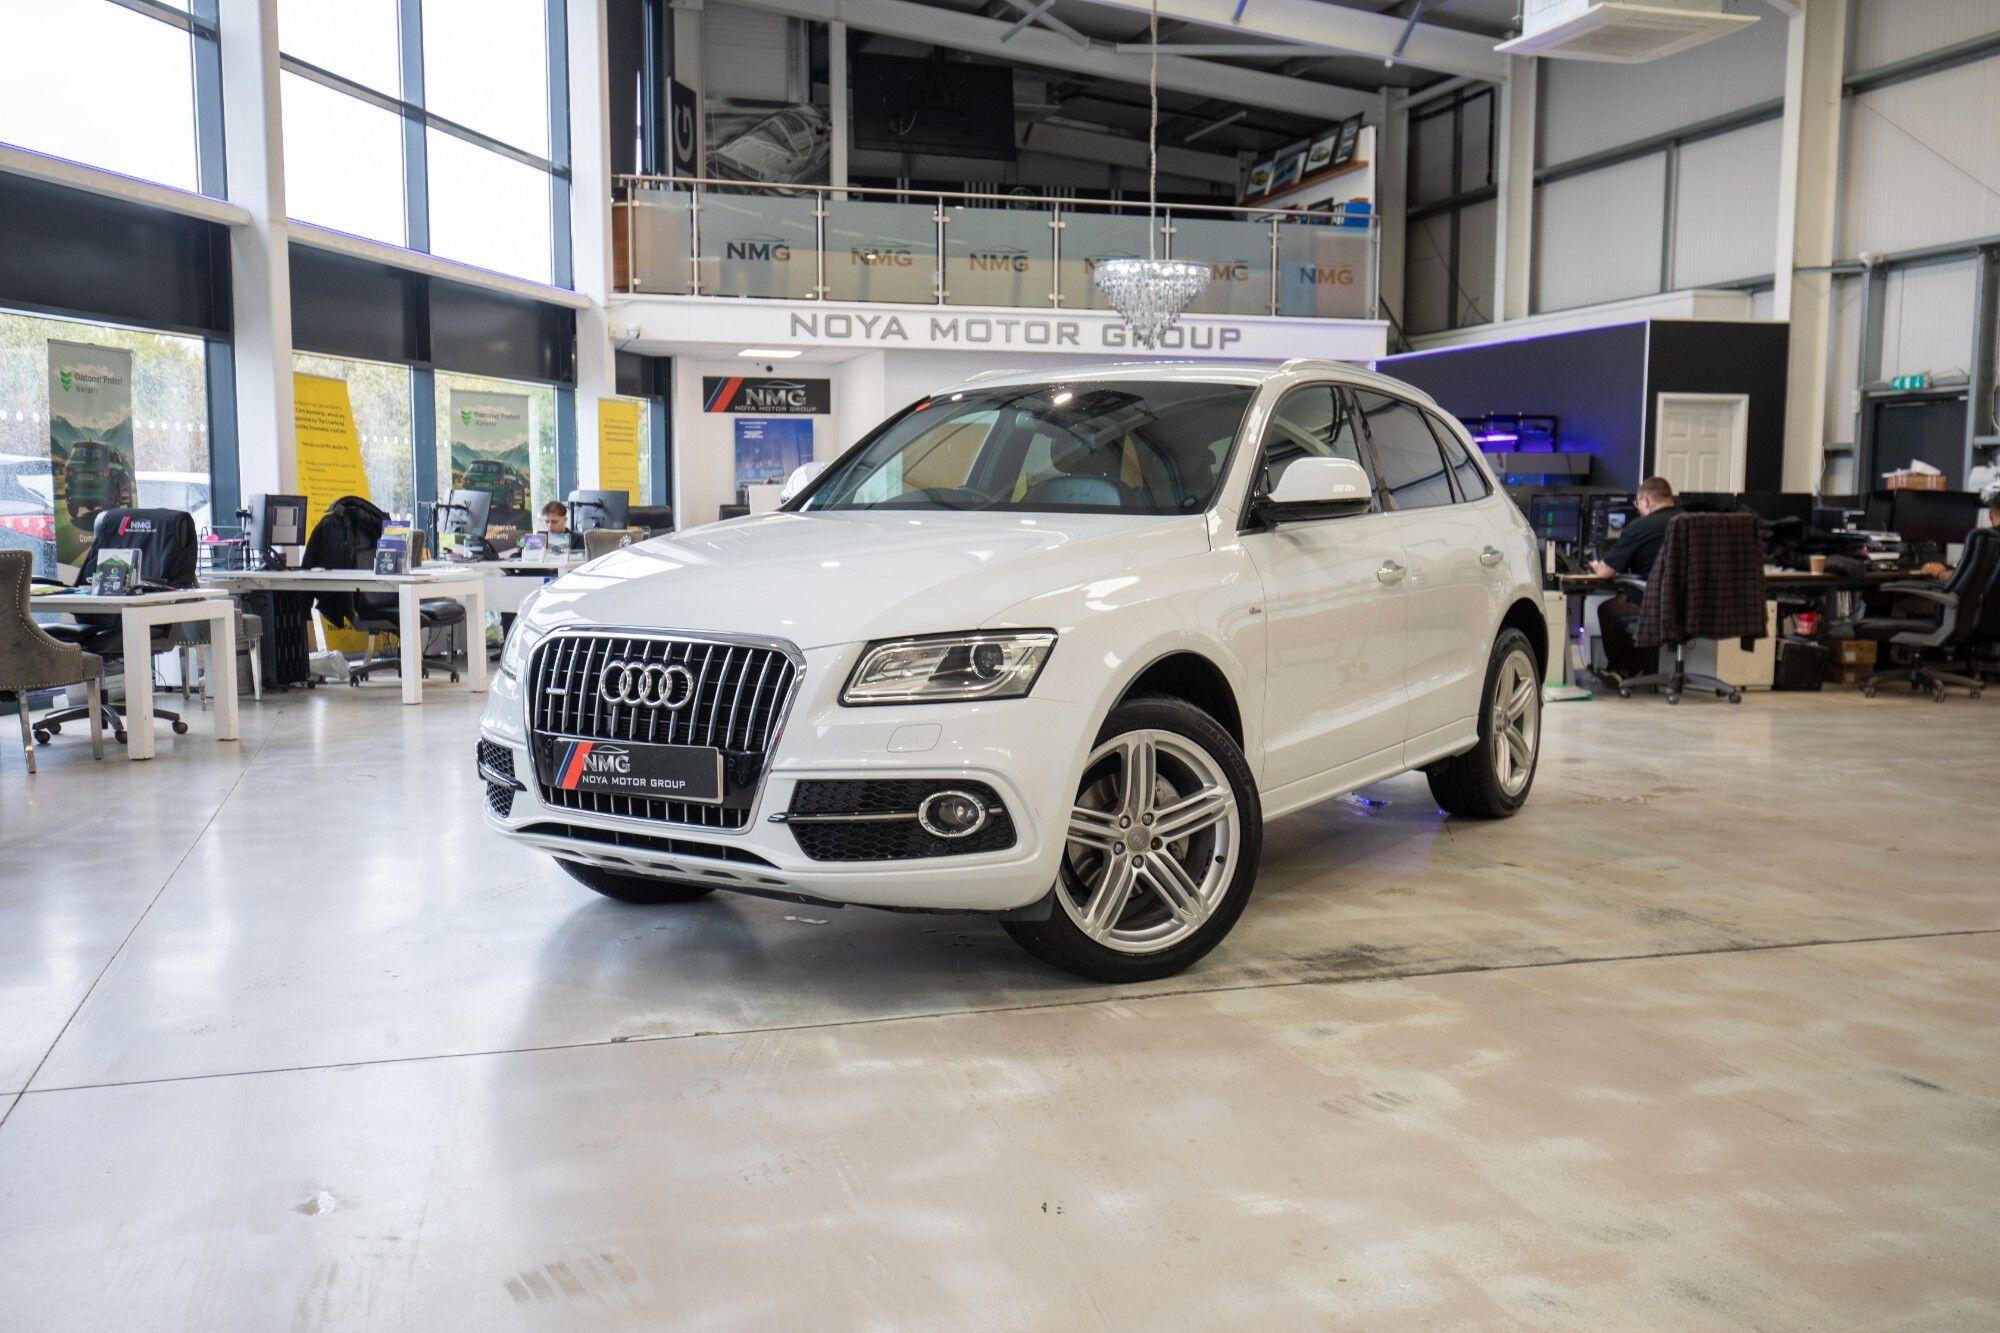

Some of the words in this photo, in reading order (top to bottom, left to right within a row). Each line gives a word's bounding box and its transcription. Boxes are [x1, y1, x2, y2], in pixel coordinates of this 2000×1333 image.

[726, 242, 790, 262] NMG
[851, 248, 913, 267] NMG
[969, 253, 1029, 272] NMG
[1209, 263, 1249, 281] MG
[1300, 265, 1354, 285] NMG
[791, 313, 908, 341] NOYA
[931, 318, 1080, 345] MOTOR
[745, 388, 807, 406] NMG
[130, 521, 152, 529] NMG
[582, 753, 631, 774] NMG
[582, 775, 609, 785] NOYA
[611, 776, 647, 787] MOTOR
[650, 778, 686, 789] GROUP
